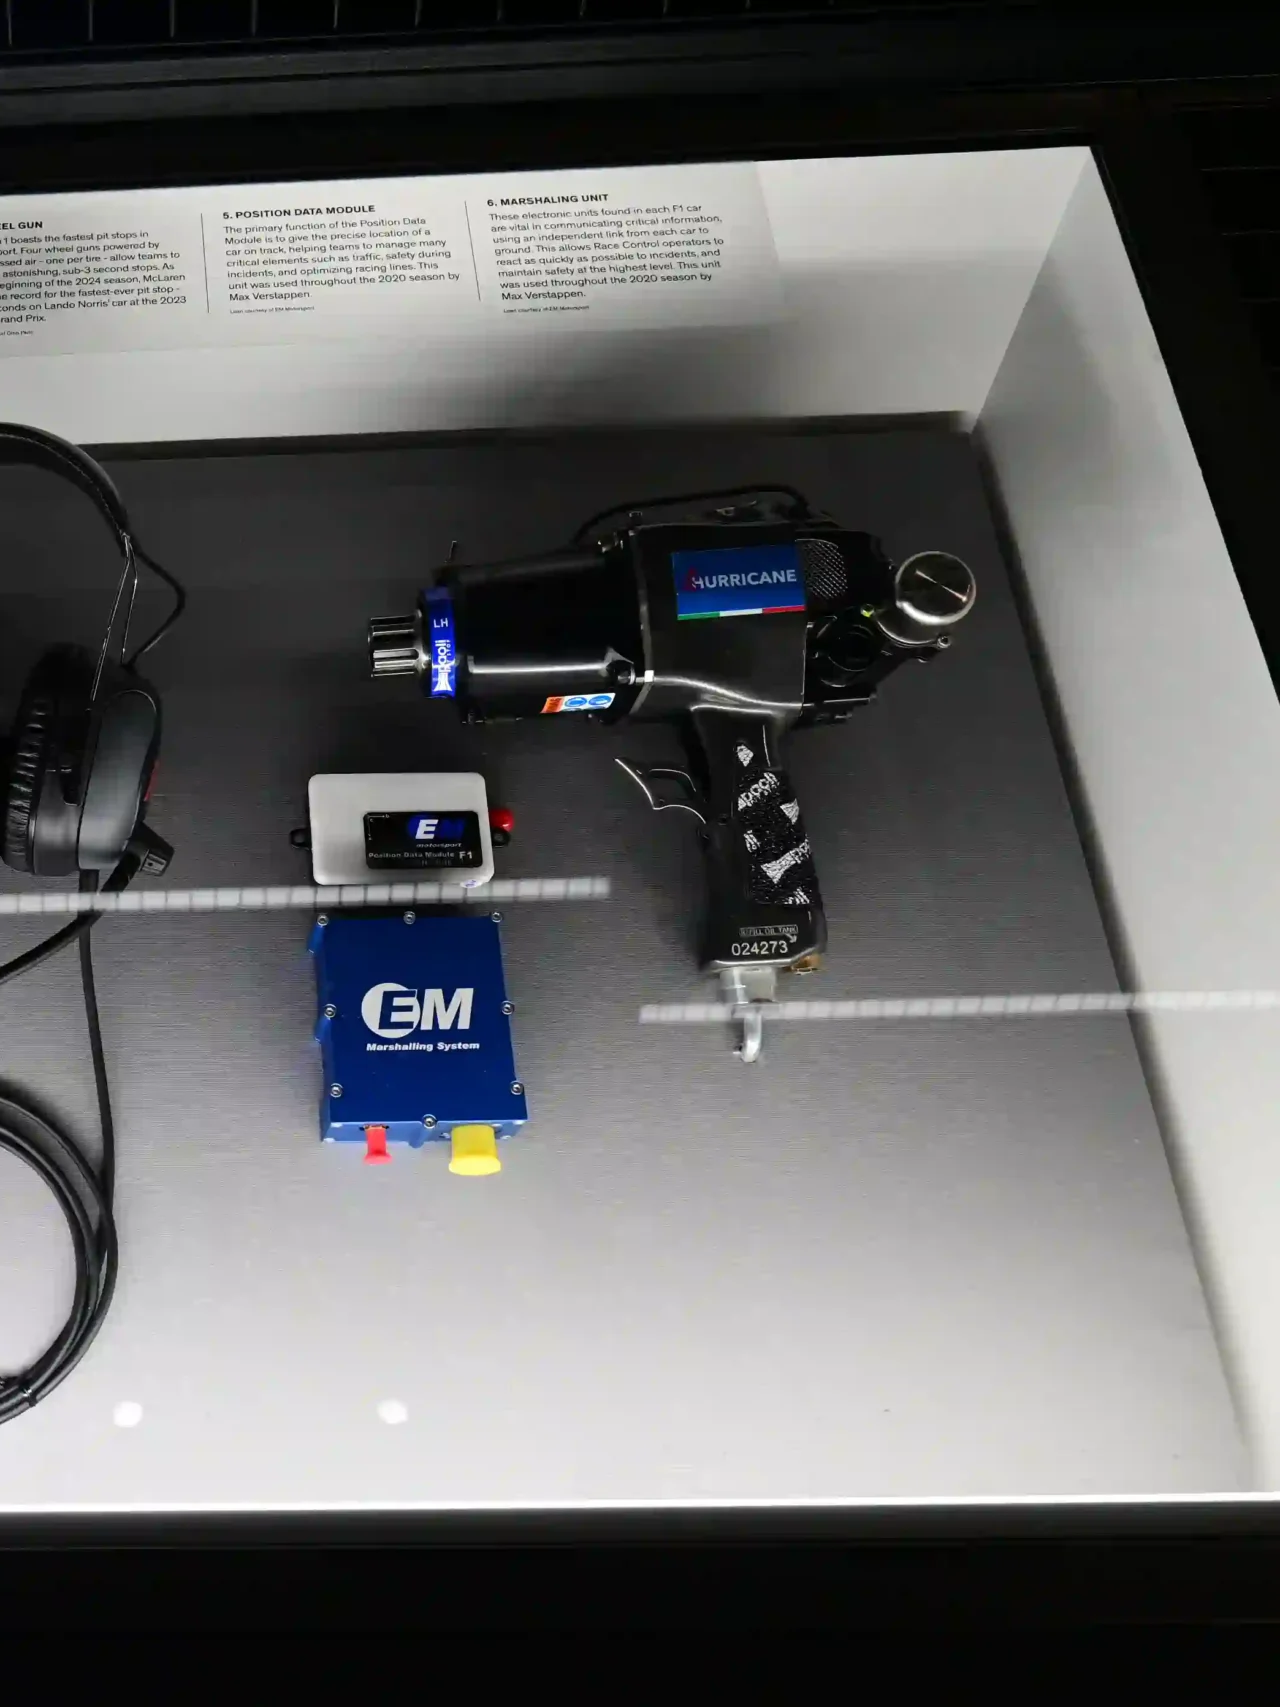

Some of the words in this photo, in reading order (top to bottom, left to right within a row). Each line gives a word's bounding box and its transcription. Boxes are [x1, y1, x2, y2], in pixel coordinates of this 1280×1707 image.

[486, 198, 497, 207] 6.
[499, 195, 578, 207] MARSHALING
[581, 193, 609, 203] UNIT
[222, 211, 232, 220] 5.
[235, 208, 291, 219] POSITION
[294, 207, 323, 217] DATA
[325, 205, 375, 215] MODULE
[18, 221, 42, 230] GUN
[223, 224, 242, 233] The
[244, 223, 283, 234] primary
[285, 221, 326, 231] function
[328, 220, 339, 229] of
[341, 219, 357, 228] the
[359, 218, 400, 227] Position
[402, 216, 426, 226] Data
[3, 236, 7, 244] 1
[10, 234, 42, 244] boasts
[44, 233, 60, 242] the
[62, 232, 93, 241] fastest
[96, 231, 109, 242] pit
[111, 230, 137, 241] stops
[139, 229, 148, 238] in
[44, 278, 54, 286] of
[56, 277, 72, 286] the
[75, 276, 100, 285] 2024
[103, 276, 140, 286] season,
[143, 273, 185, 282] McLaren
[522, 278, 548, 287] used
[550, 276, 608, 288] throughout
[609, 275, 627, 284] the
[628, 274, 658, 283] 2020
[660, 274, 697, 282] season
[699, 272, 712, 283] by
[229, 292, 250, 300] Max
[252, 290, 311, 302] Verstappen.
[501, 290, 522, 299] Max
[524, 289, 586, 300] Verstappen.
[25, 313, 45, 322] Prix.
[692, 569, 797, 589] HURRICANE
[434, 618, 448, 628] LH
[459, 851, 473, 860] F1
[731, 940, 788, 956] 024273
[375, 986, 474, 1032] EM
[366, 1042, 433, 1052] Marshalling
[436, 1041, 480, 1052] System
